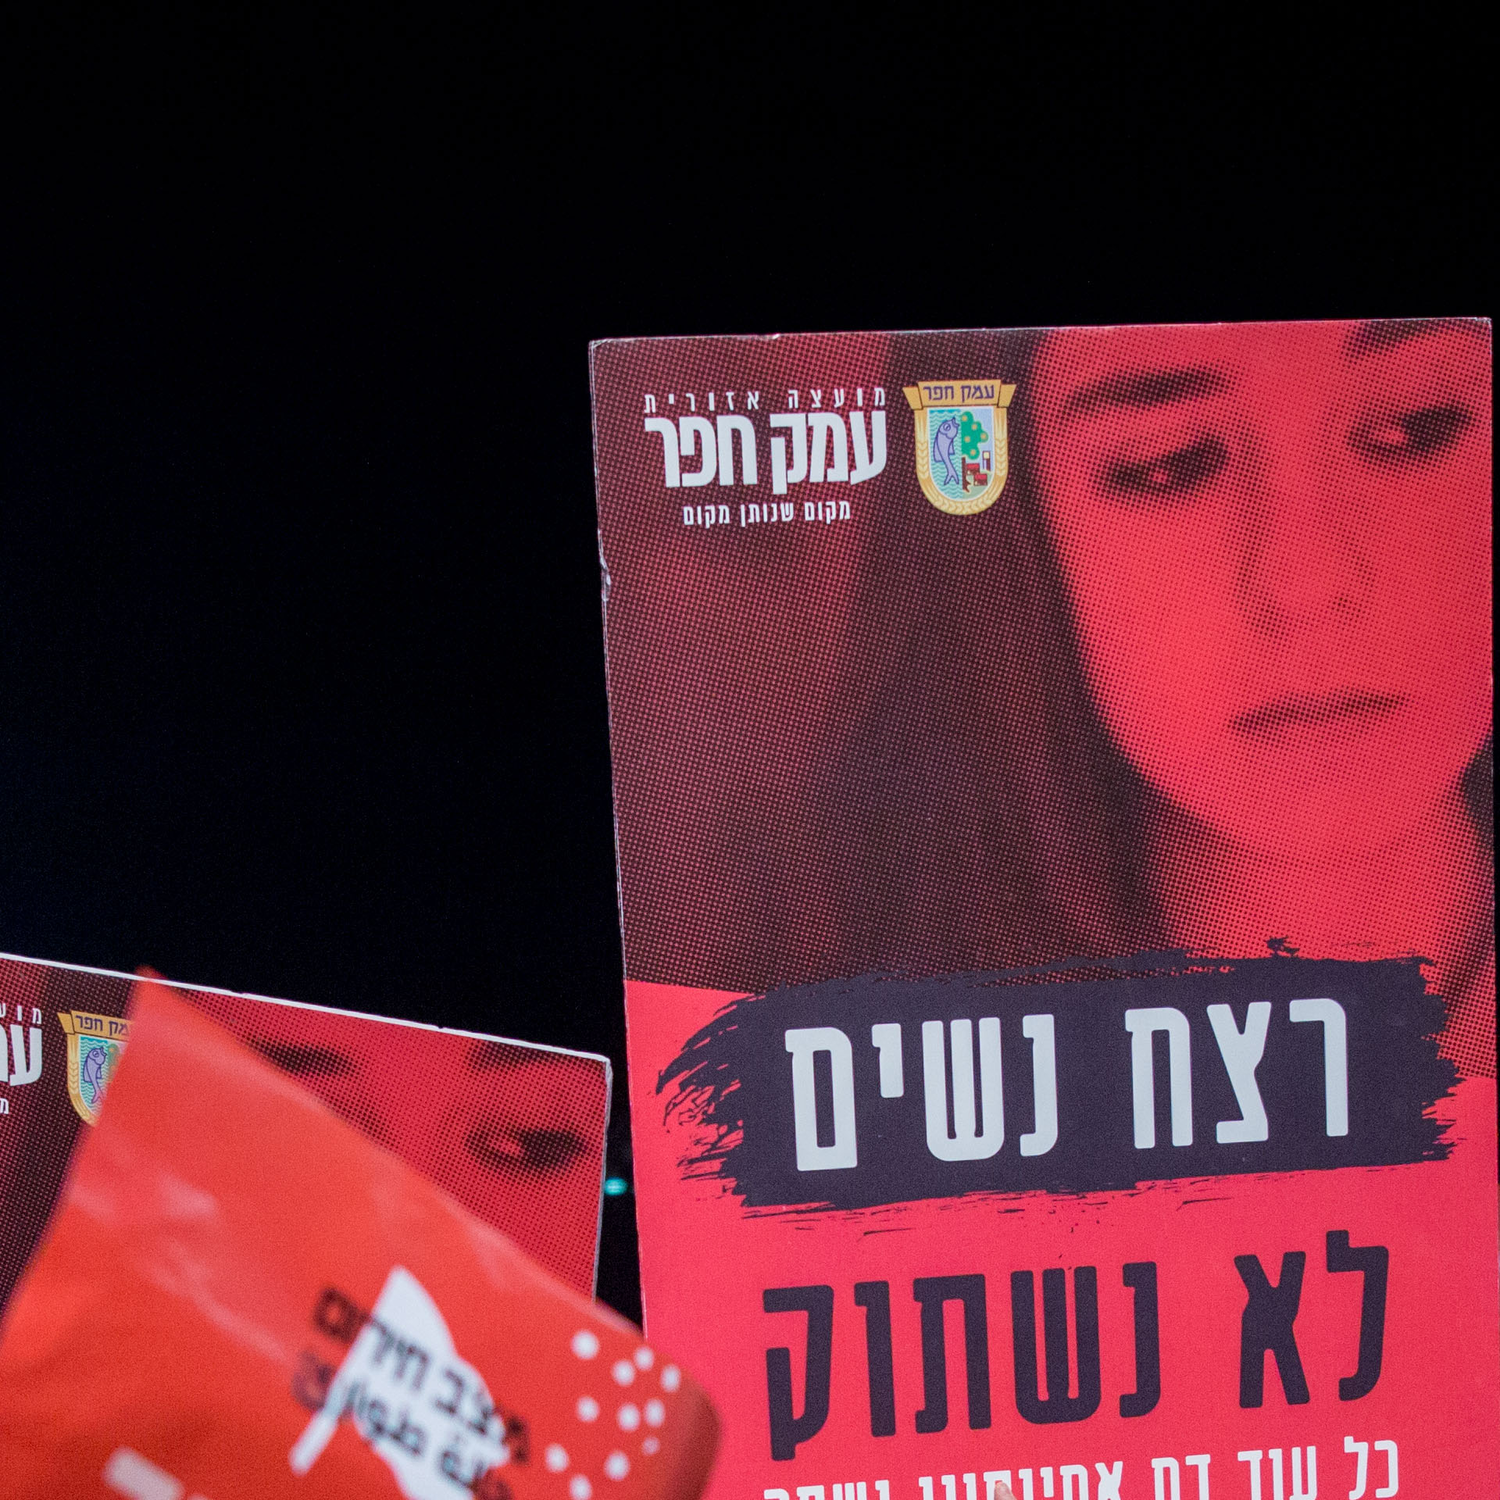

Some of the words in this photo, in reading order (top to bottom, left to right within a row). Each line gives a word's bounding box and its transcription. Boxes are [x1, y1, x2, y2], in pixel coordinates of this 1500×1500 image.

[644, 389, 760, 414] אזורית
[788, 386, 886, 410] מועצה
[922, 384, 955, 402] חפר
[959, 383, 996, 401] עמק
[644, 414, 758, 488] חפר
[769, 410, 888, 495] עמק
[683, 505, 730, 529] מקום
[739, 502, 795, 528] שנותן
[804, 500, 851, 525] מקום
[74, 1013, 104, 1032] חפר
[108, 1018, 132, 1036] מק
[1125, 996, 1350, 1150] רצח
[783, 1012, 1060, 1172] נשים
[1232, 1229, 1390, 1409] לא
[762, 1260, 1162, 1461] נשתוק
[1344, 1435, 1401, 1500] כל
